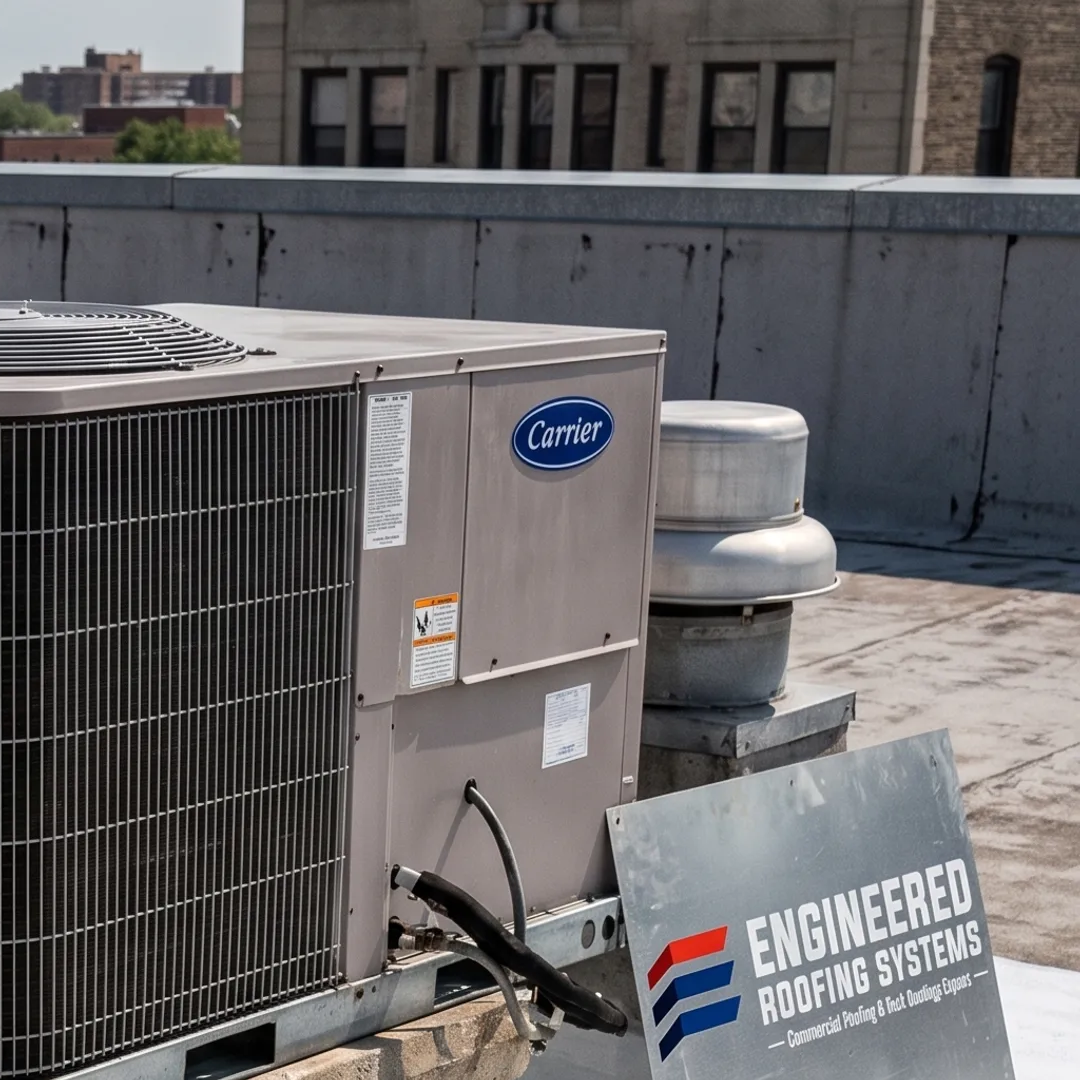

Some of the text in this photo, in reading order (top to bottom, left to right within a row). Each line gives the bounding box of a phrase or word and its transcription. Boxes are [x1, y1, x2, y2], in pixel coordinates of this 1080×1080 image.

[527, 416, 603, 450] Carrier
[746, 858, 973, 978] ENGINEERED
[758, 920, 982, 1026] ROOFING SYSTEMS
[787, 1014, 842, 1048] Commercial
